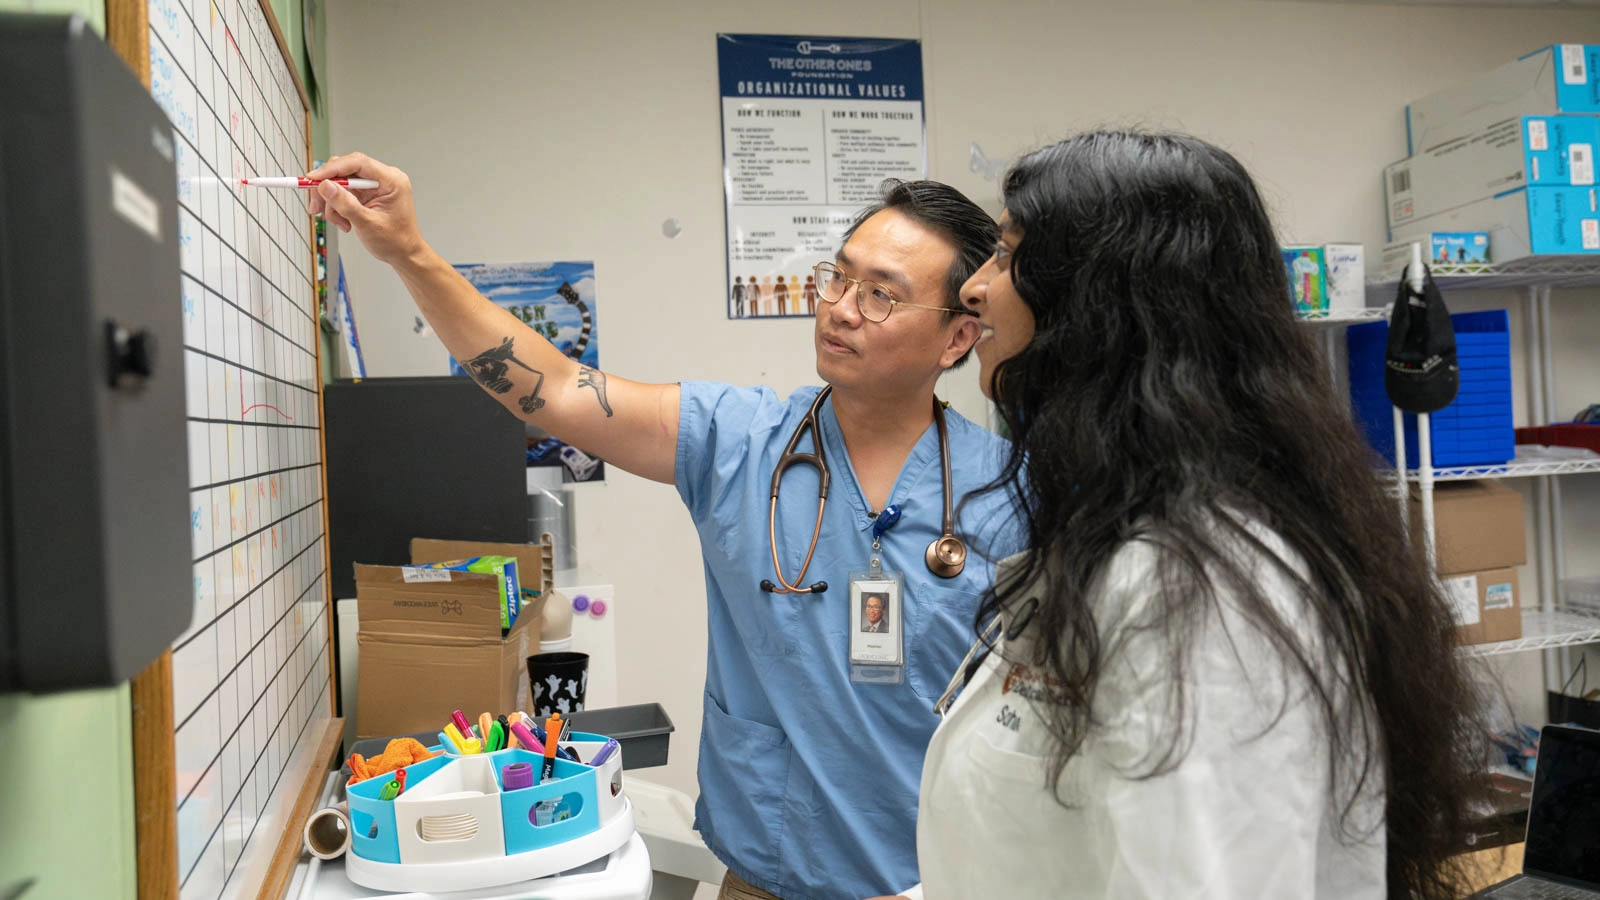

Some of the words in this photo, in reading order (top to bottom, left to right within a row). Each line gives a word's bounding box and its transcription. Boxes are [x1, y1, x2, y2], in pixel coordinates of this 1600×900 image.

[769, 57, 795, 70] THE
[795, 58, 835, 71] OTHER
[836, 59, 872, 72] ONES
[791, 71, 854, 79] FOUNDATION
[737, 81, 851, 97] ORGANIZATIONAL
[858, 84, 906, 98] VALUES
[737, 109, 751, 118] HOW
[767, 109, 801, 118] FUNCTION
[832, 110, 846, 119] HOW
[861, 111, 878, 119] WORK
[881, 112, 914, 121] TOGETHER
[506, 575, 517, 617] Ziploc
